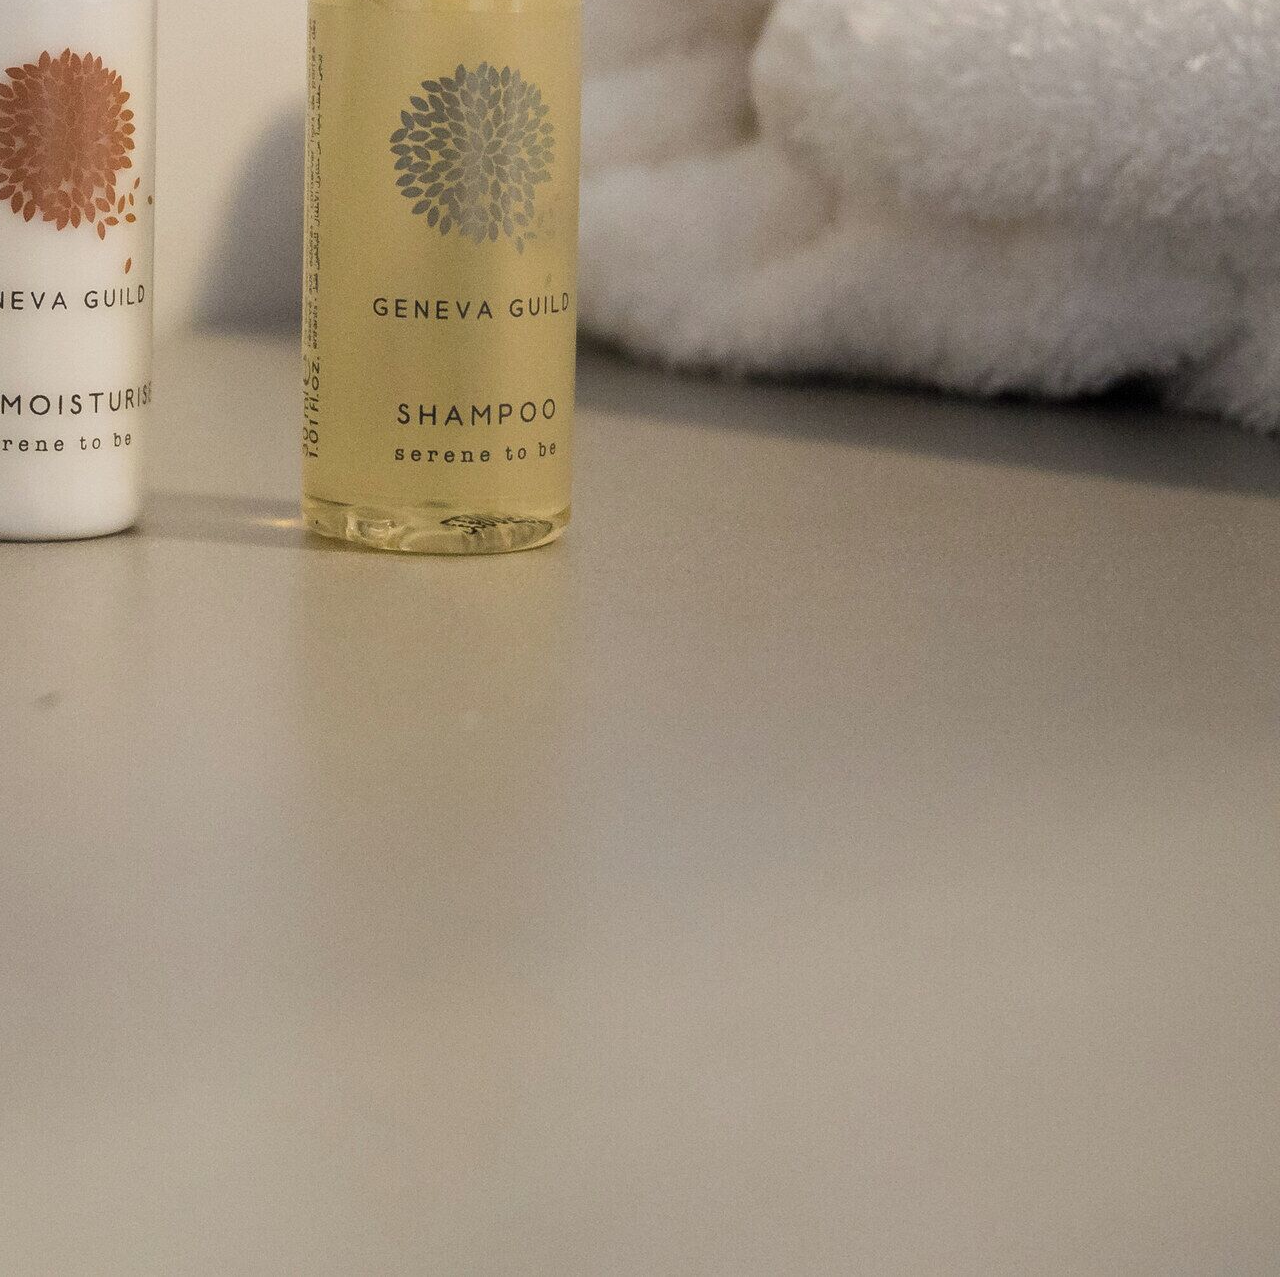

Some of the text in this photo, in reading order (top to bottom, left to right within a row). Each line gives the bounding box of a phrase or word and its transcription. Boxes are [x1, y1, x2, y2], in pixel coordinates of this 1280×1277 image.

[83, 284, 145, 309] GUILD
[373, 292, 570, 320] GENEVA GUILD
[397, 398, 557, 426] SHAMPOO
[80, 436, 101, 451] to
[113, 432, 132, 447] be
[308, 419, 319, 459] 1.01
[394, 442, 558, 463] serene to be
